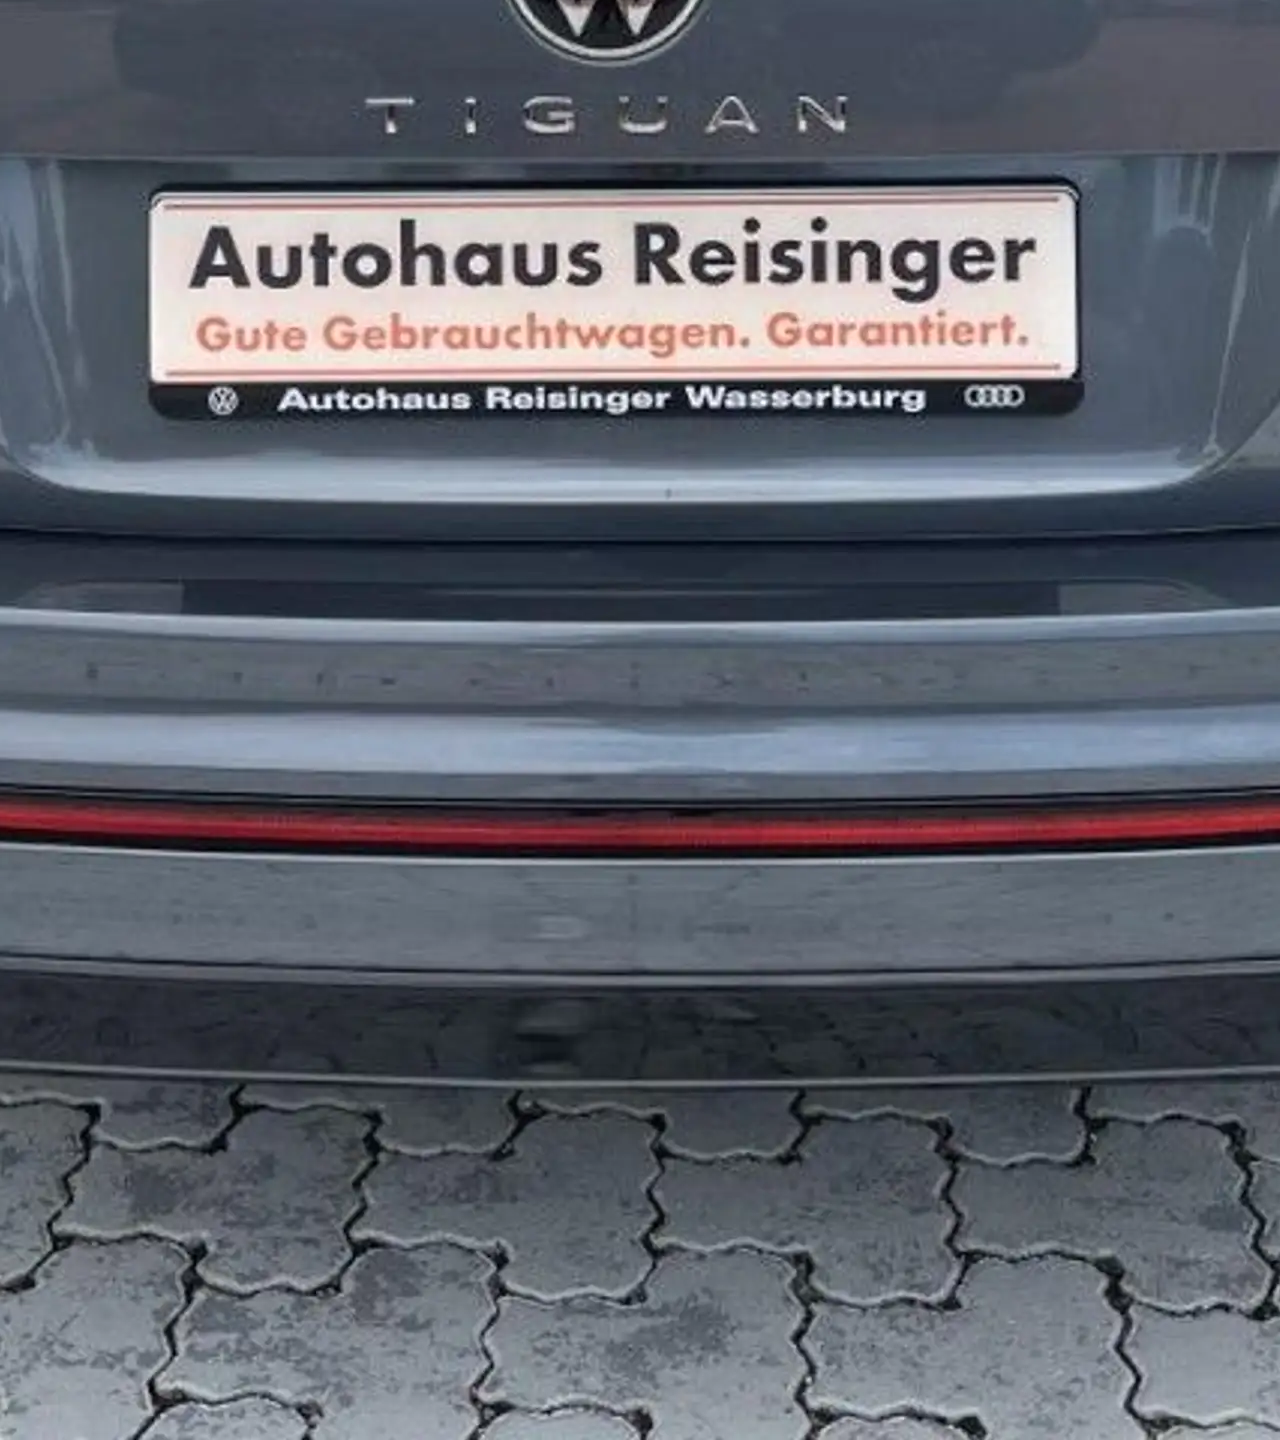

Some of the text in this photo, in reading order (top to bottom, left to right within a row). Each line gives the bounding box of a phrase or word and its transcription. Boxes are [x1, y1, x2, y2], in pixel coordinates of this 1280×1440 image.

[365, 95, 848, 135] TIGUAN
[188, 216, 1037, 304] Autohaus Reisinger
[195, 310, 1029, 359] Gute Gebrauchtwagen. Garantiert.
[277, 387, 472, 412] Autohaus
[485, 385, 671, 414] Reisinger
[685, 384, 927, 414] Wasserburg
